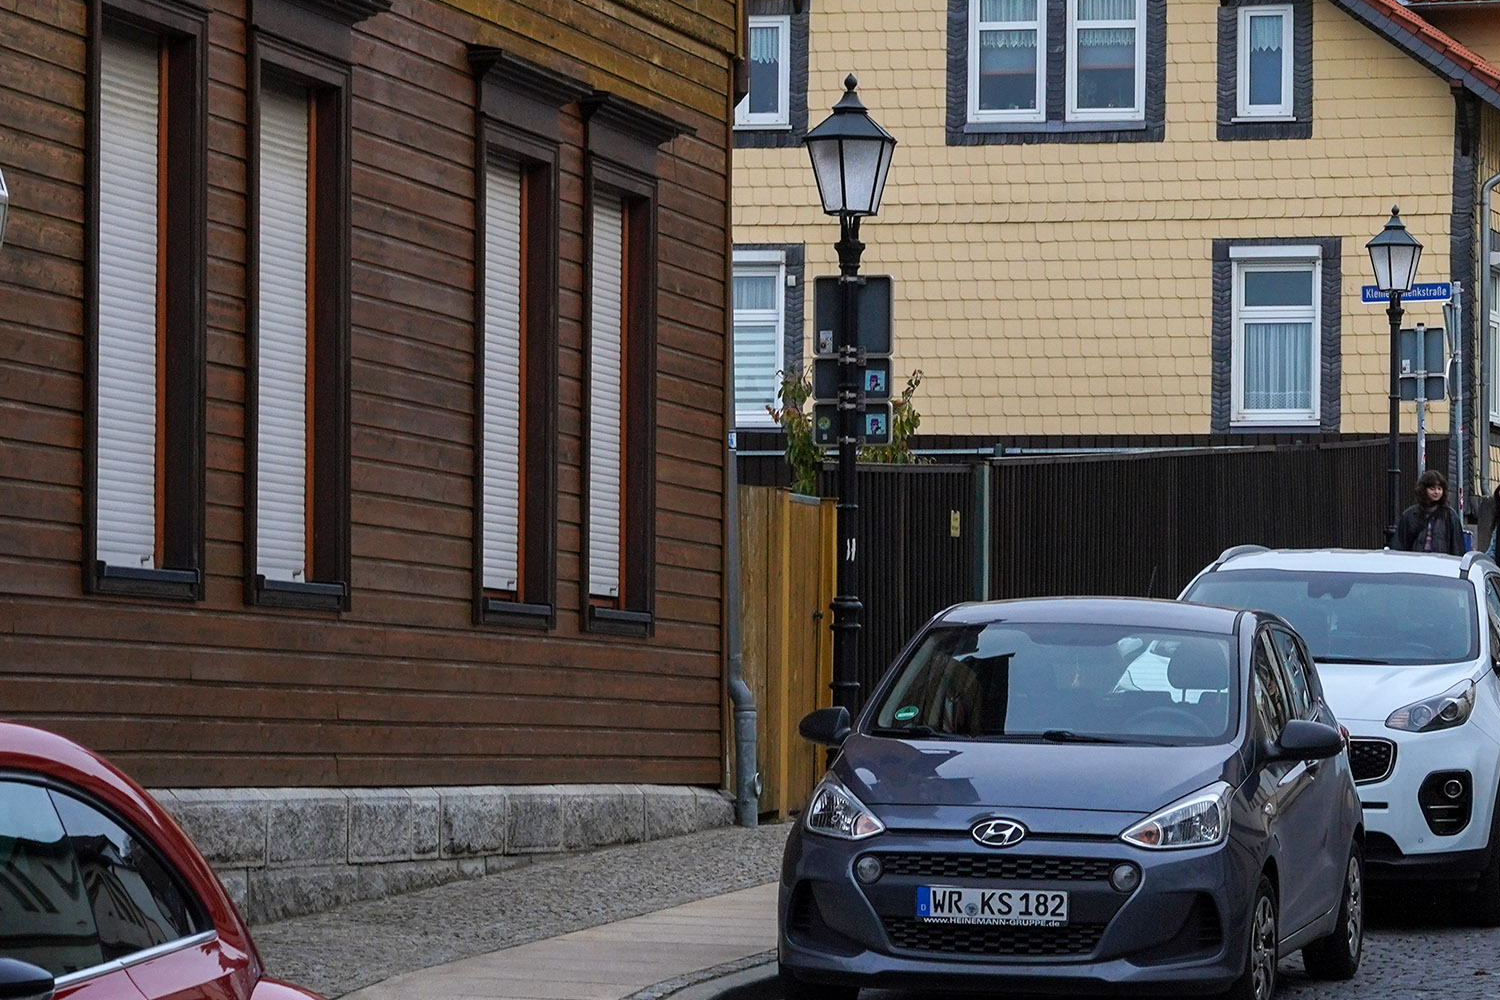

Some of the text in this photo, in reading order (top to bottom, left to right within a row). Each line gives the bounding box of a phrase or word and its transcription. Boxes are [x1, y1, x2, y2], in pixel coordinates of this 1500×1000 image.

[932, 890, 1065, 917] WR KS 182
[923, 917, 1060, 927] www.HEINEMANN-GRUPPE.de
